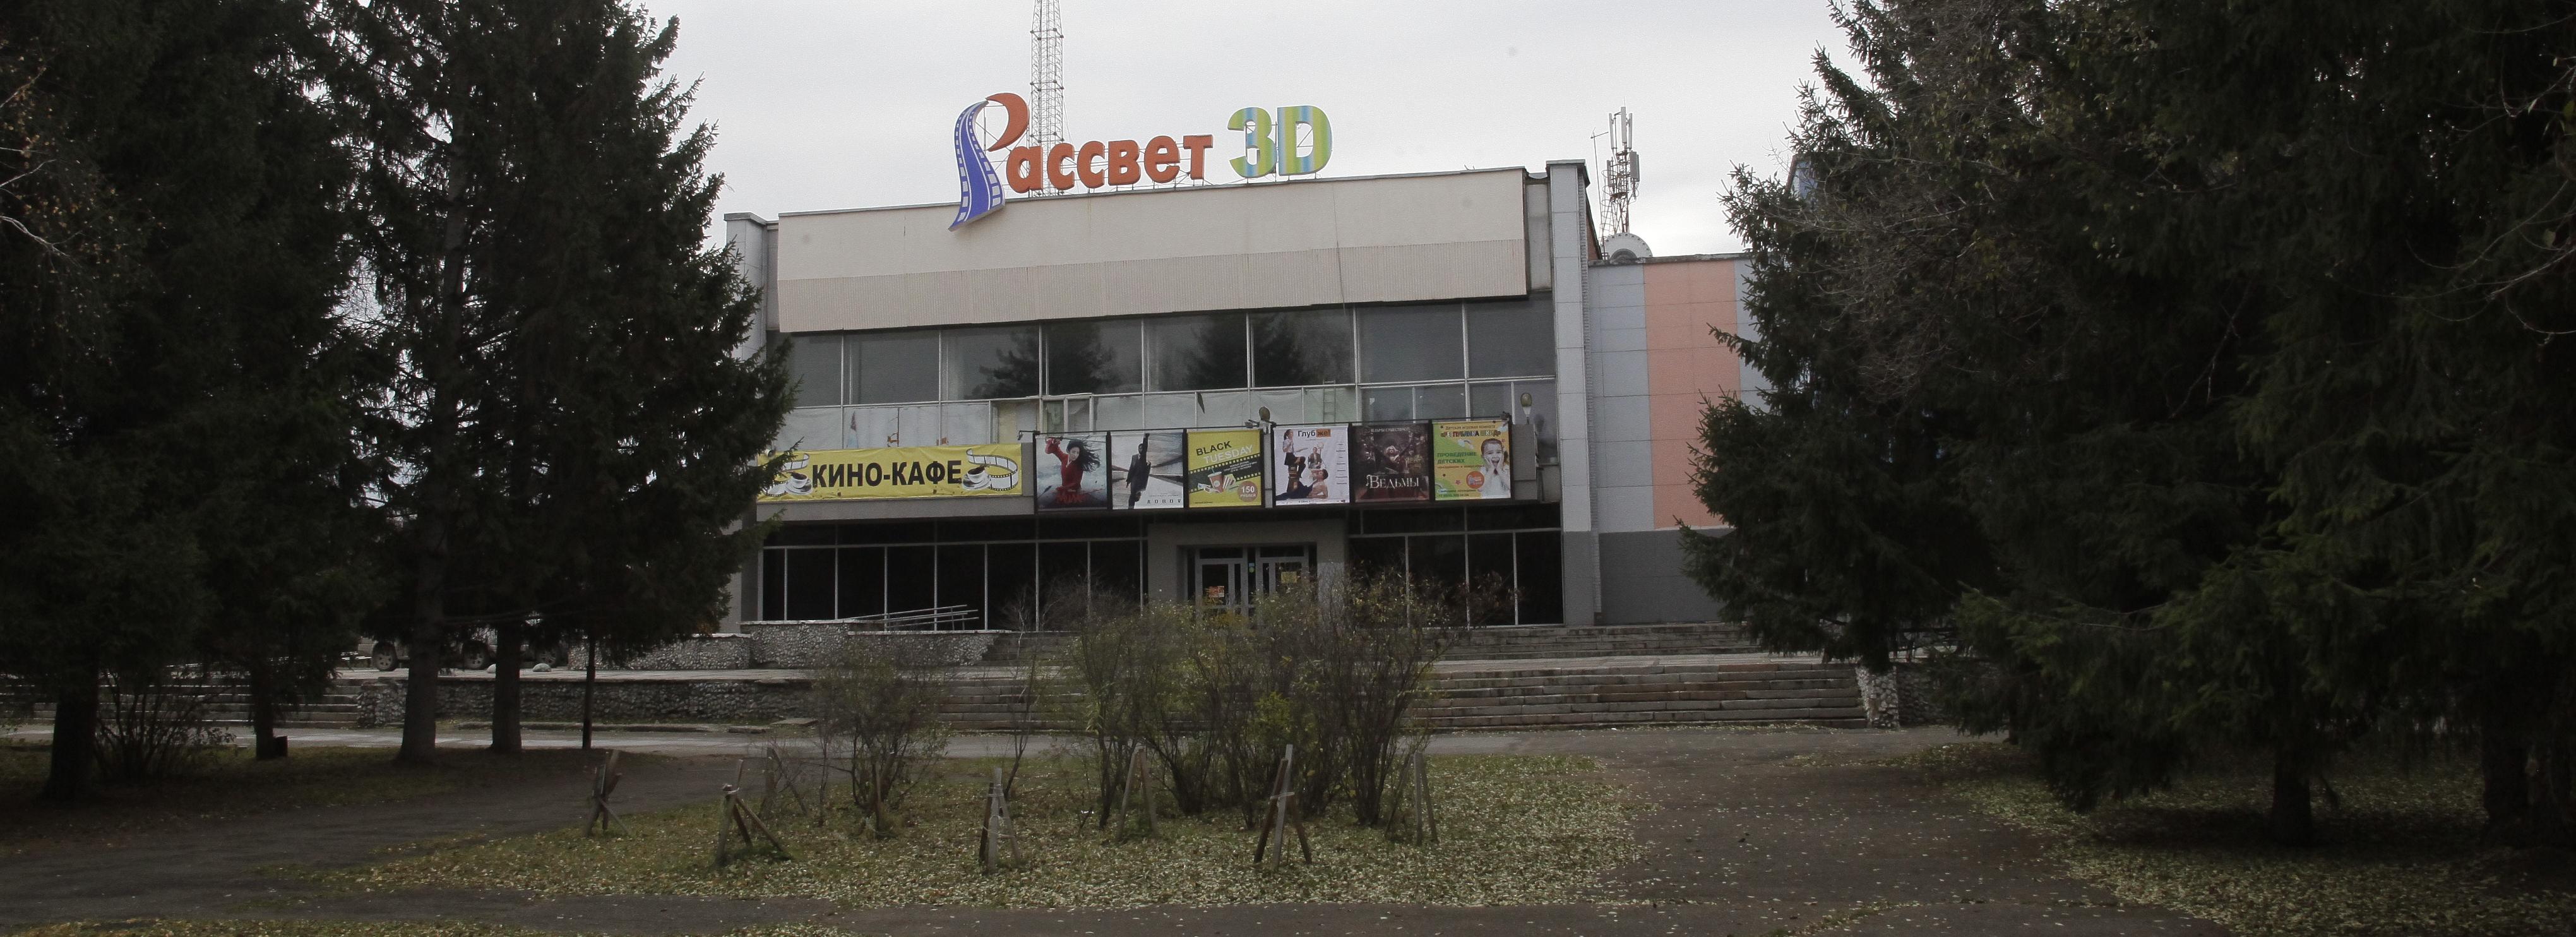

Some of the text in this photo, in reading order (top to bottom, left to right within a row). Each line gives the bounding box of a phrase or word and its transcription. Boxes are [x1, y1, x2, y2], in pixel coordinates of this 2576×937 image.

[948, 92, 1333, 232] Рассвет 3D
[1196, 440, 1232, 456] BLACK
[1204, 445, 1253, 464] TUESDAY
[812, 460, 962, 489] КИНО-КАФЕ
